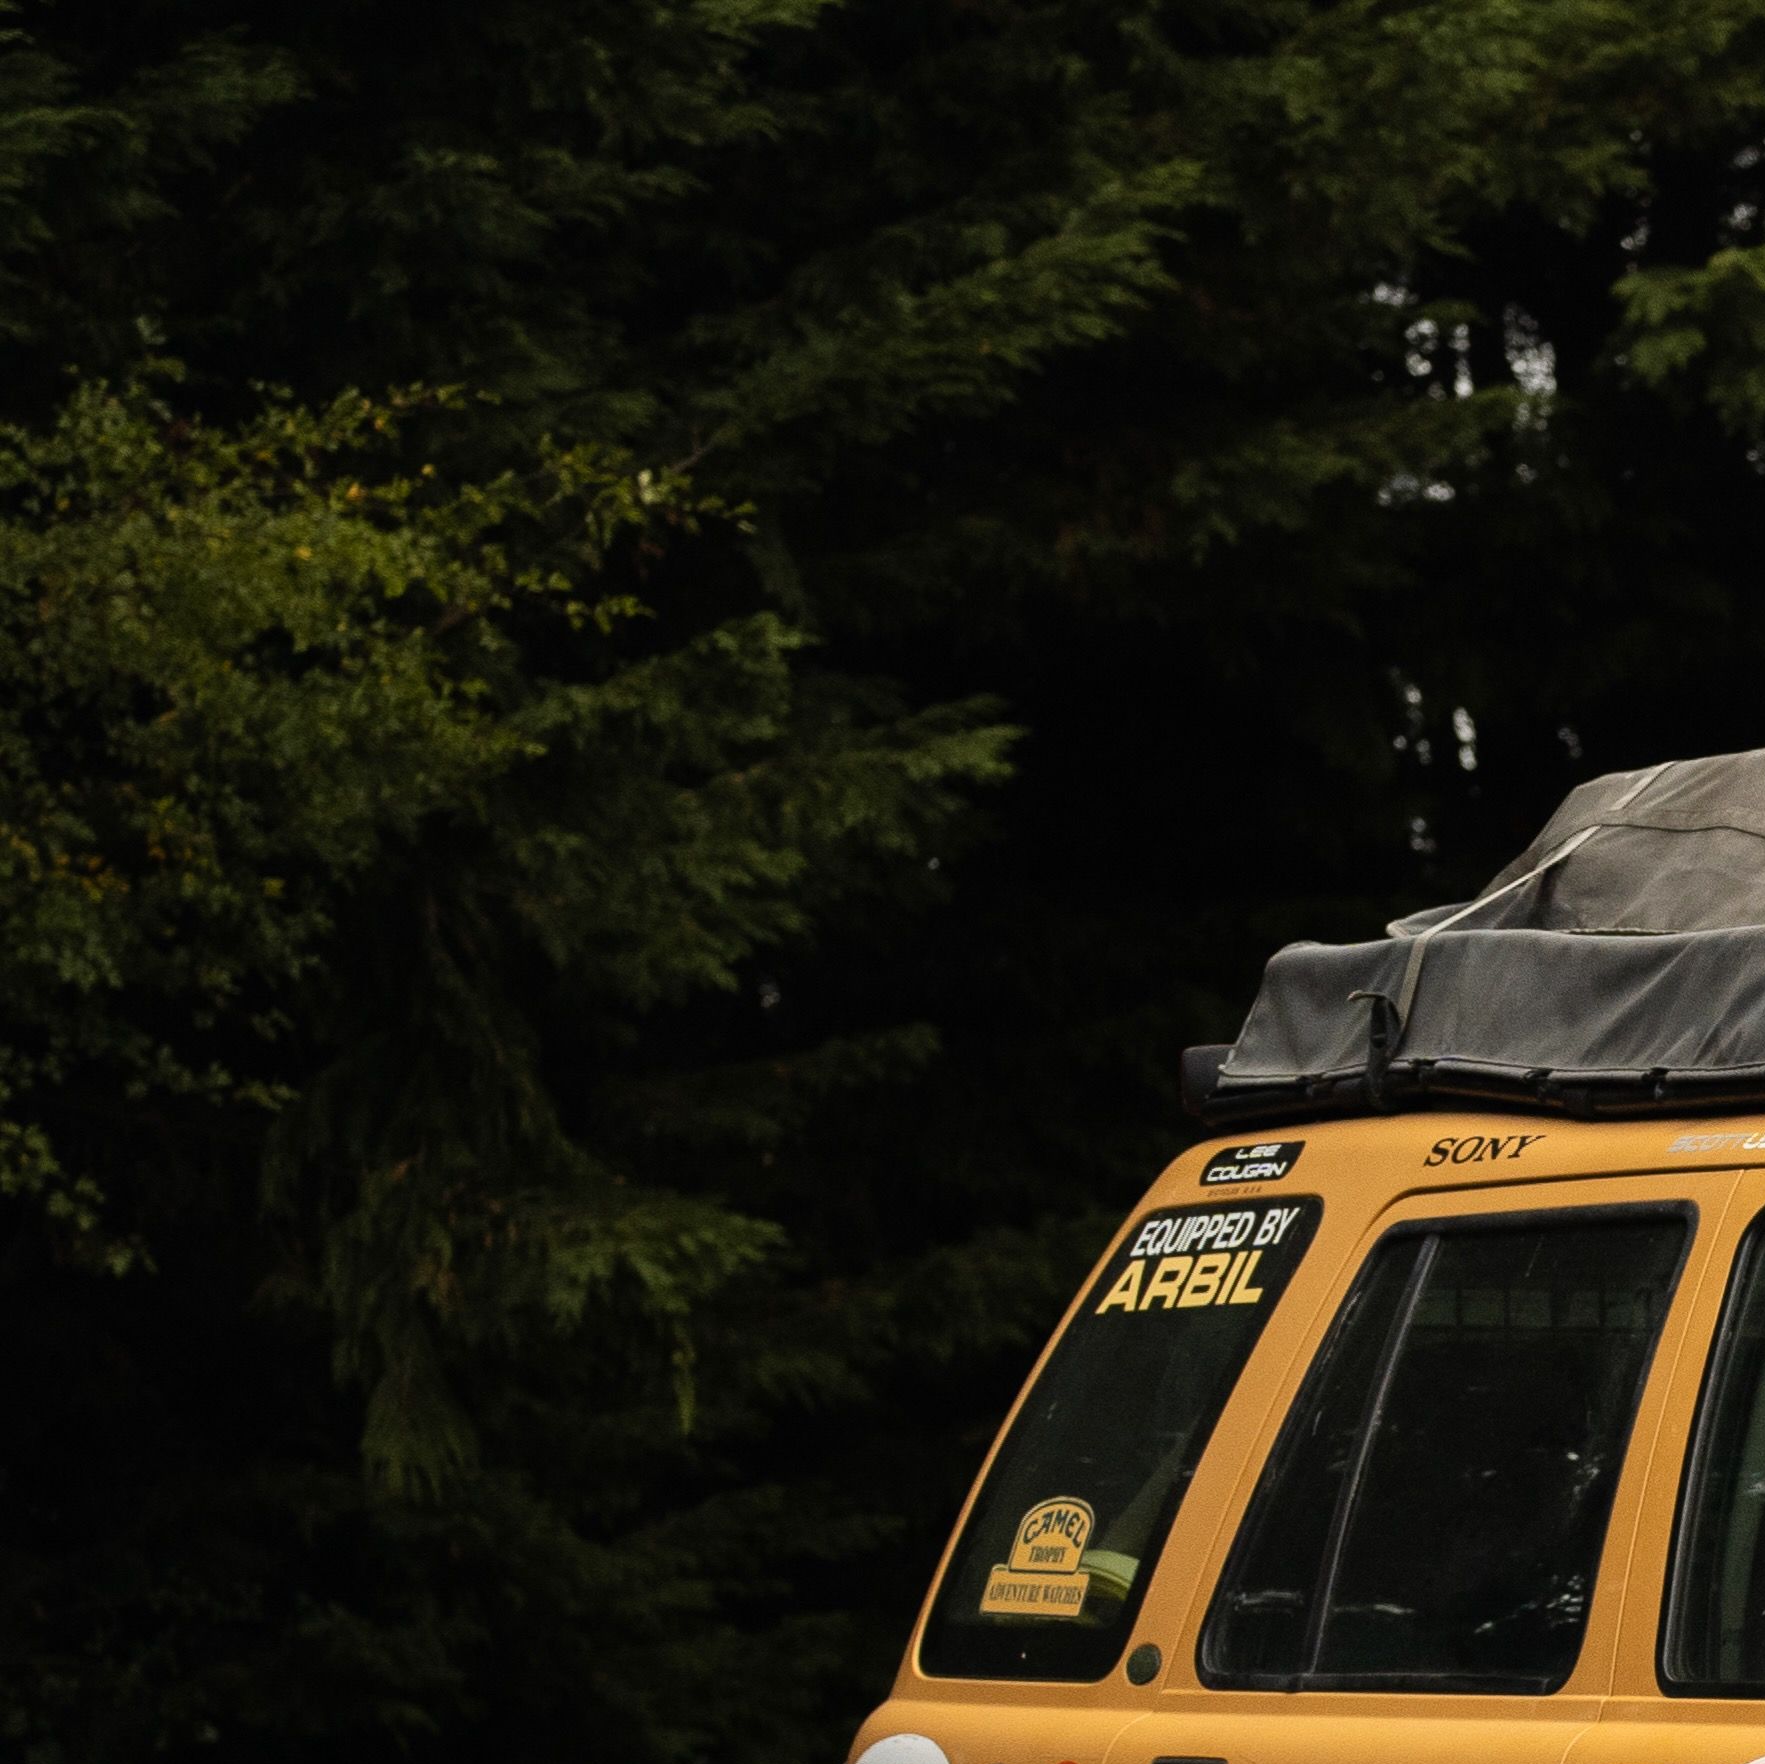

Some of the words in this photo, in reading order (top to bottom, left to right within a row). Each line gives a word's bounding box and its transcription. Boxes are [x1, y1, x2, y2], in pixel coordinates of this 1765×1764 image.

[1235, 1144, 1282, 1159] LEE
[1423, 1135, 1547, 1167] SONY
[1130, 1211, 1256, 1257] EQUIPPED
[1253, 1207, 1300, 1246] BY
[1095, 1250, 1264, 1315] ARBIL
[1023, 1508, 1084, 1548] CAMEL
